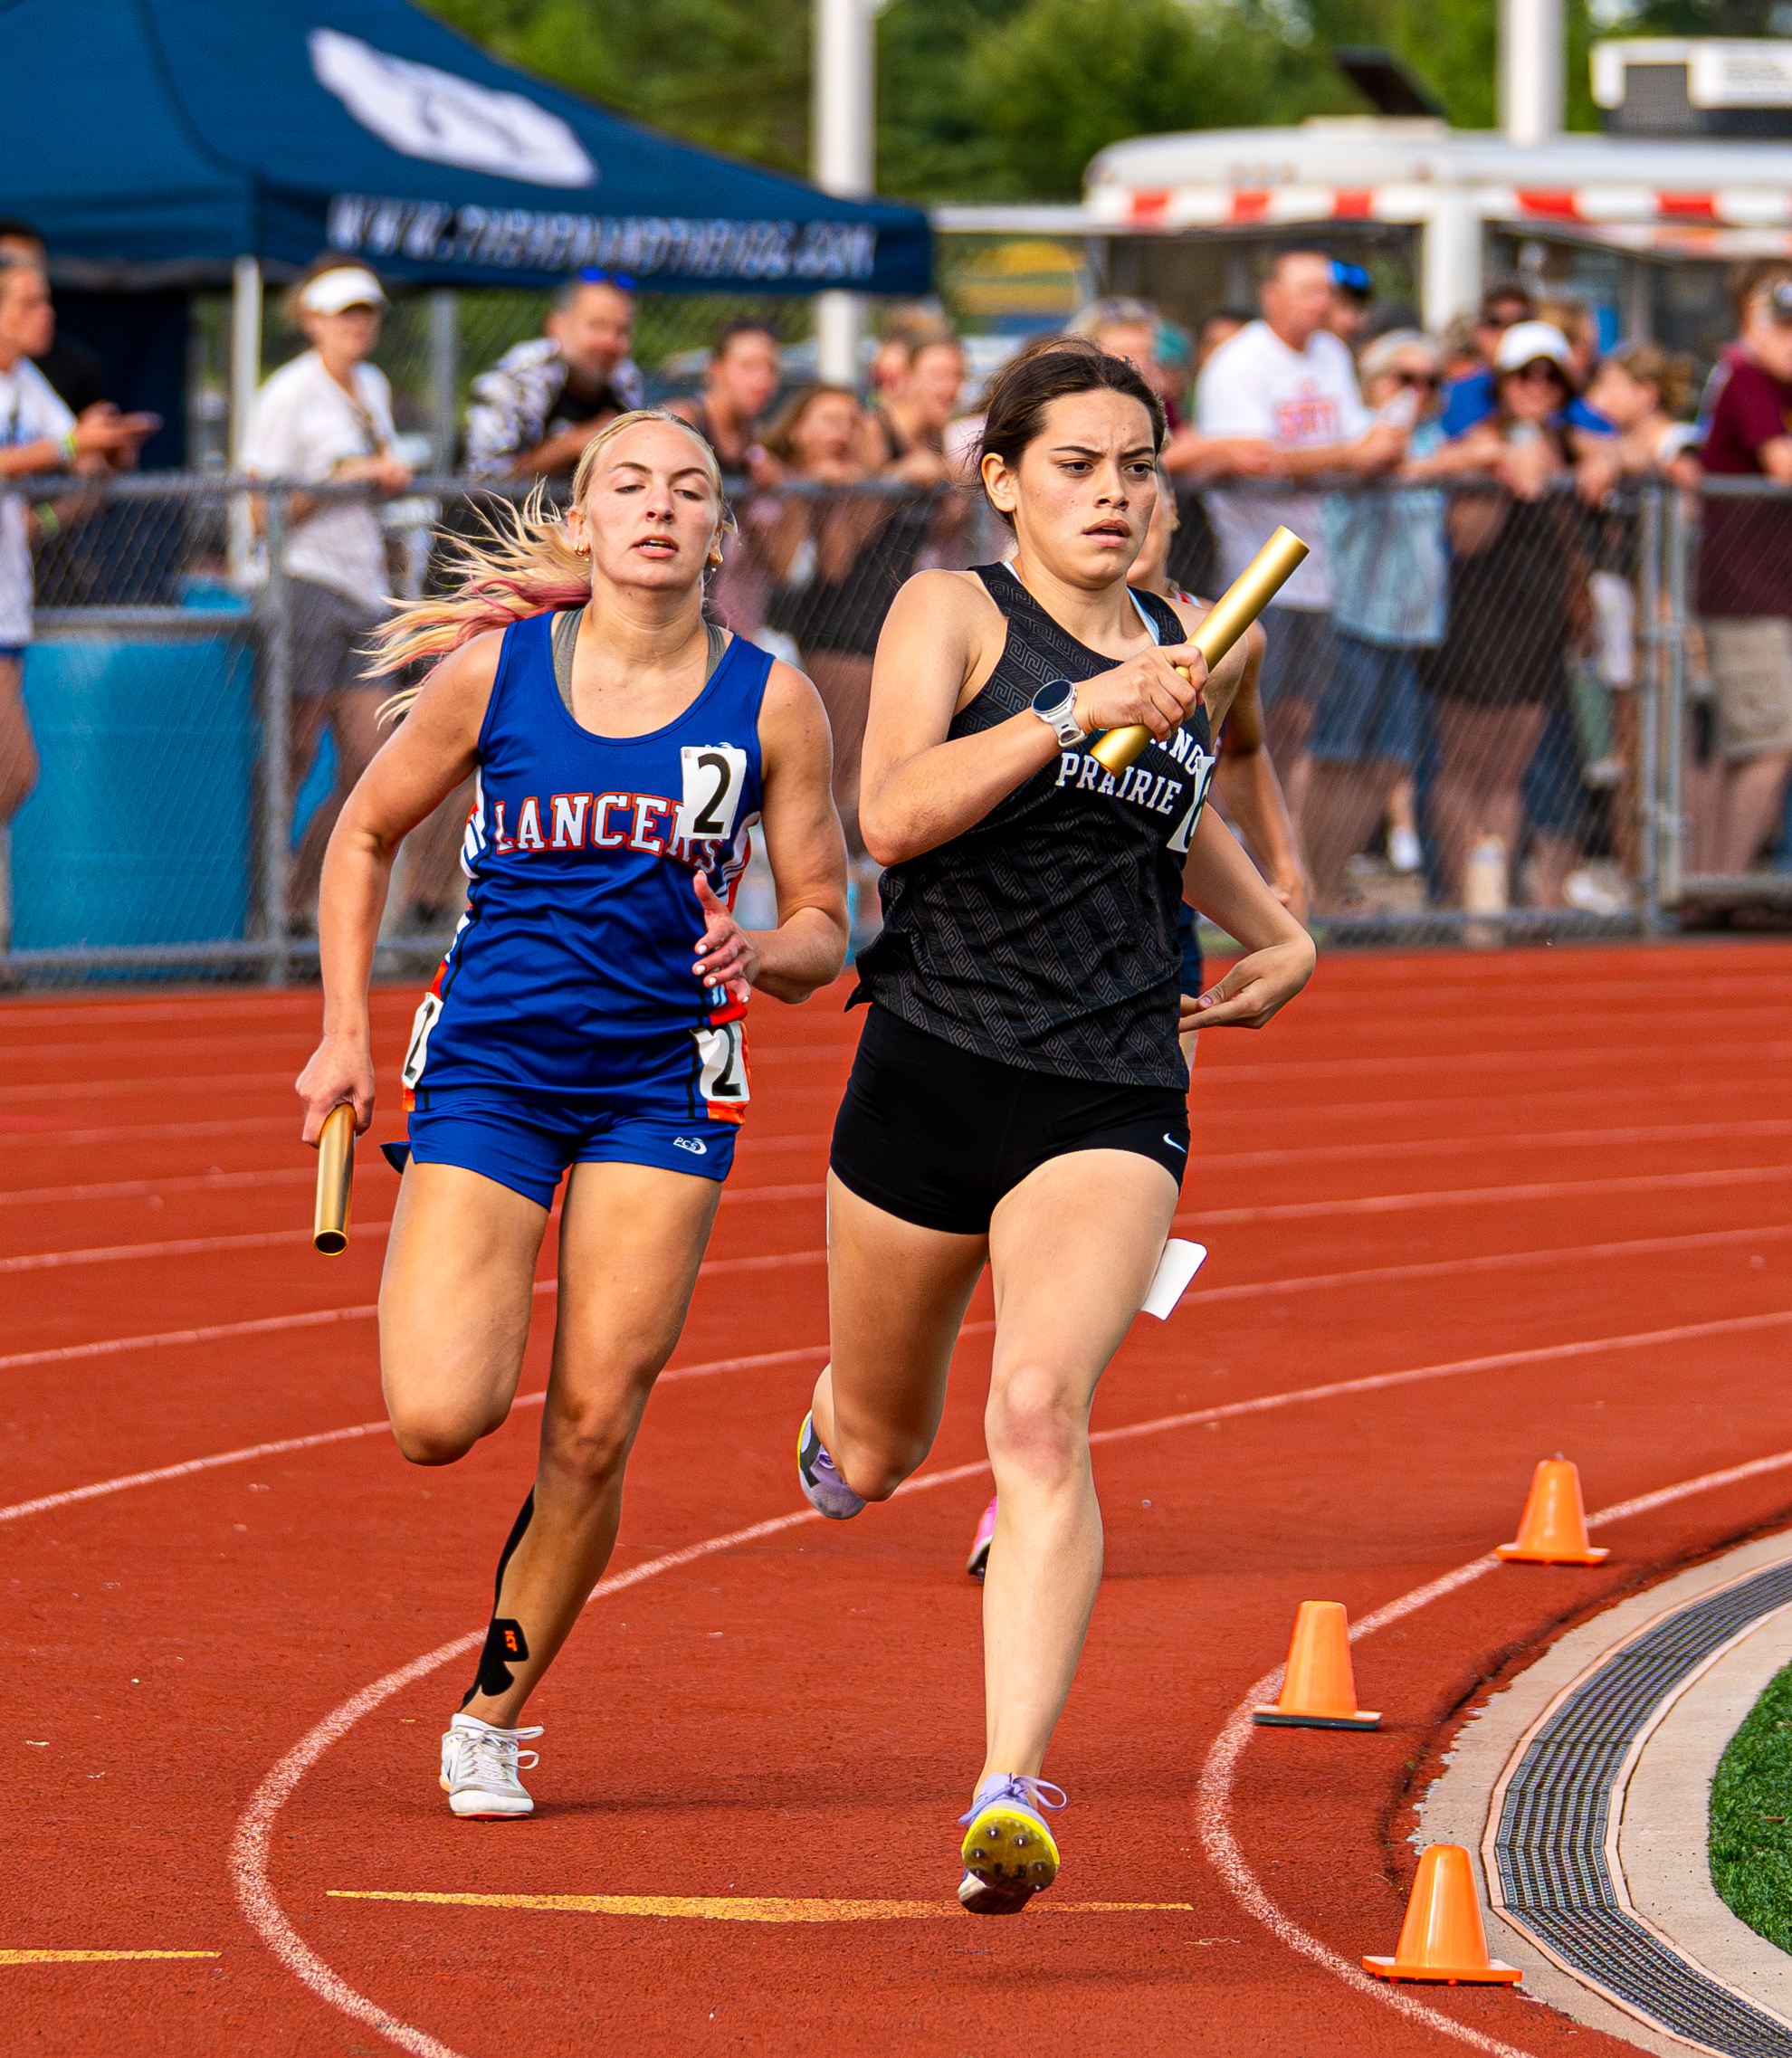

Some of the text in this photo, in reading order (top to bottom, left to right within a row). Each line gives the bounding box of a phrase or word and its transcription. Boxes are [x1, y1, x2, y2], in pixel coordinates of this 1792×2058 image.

[693, 753, 731, 834] 2
[1055, 752, 1183, 815] PRAIRIE
[404, 1001, 436, 1081] 2
[710, 1023, 742, 1096] 2
